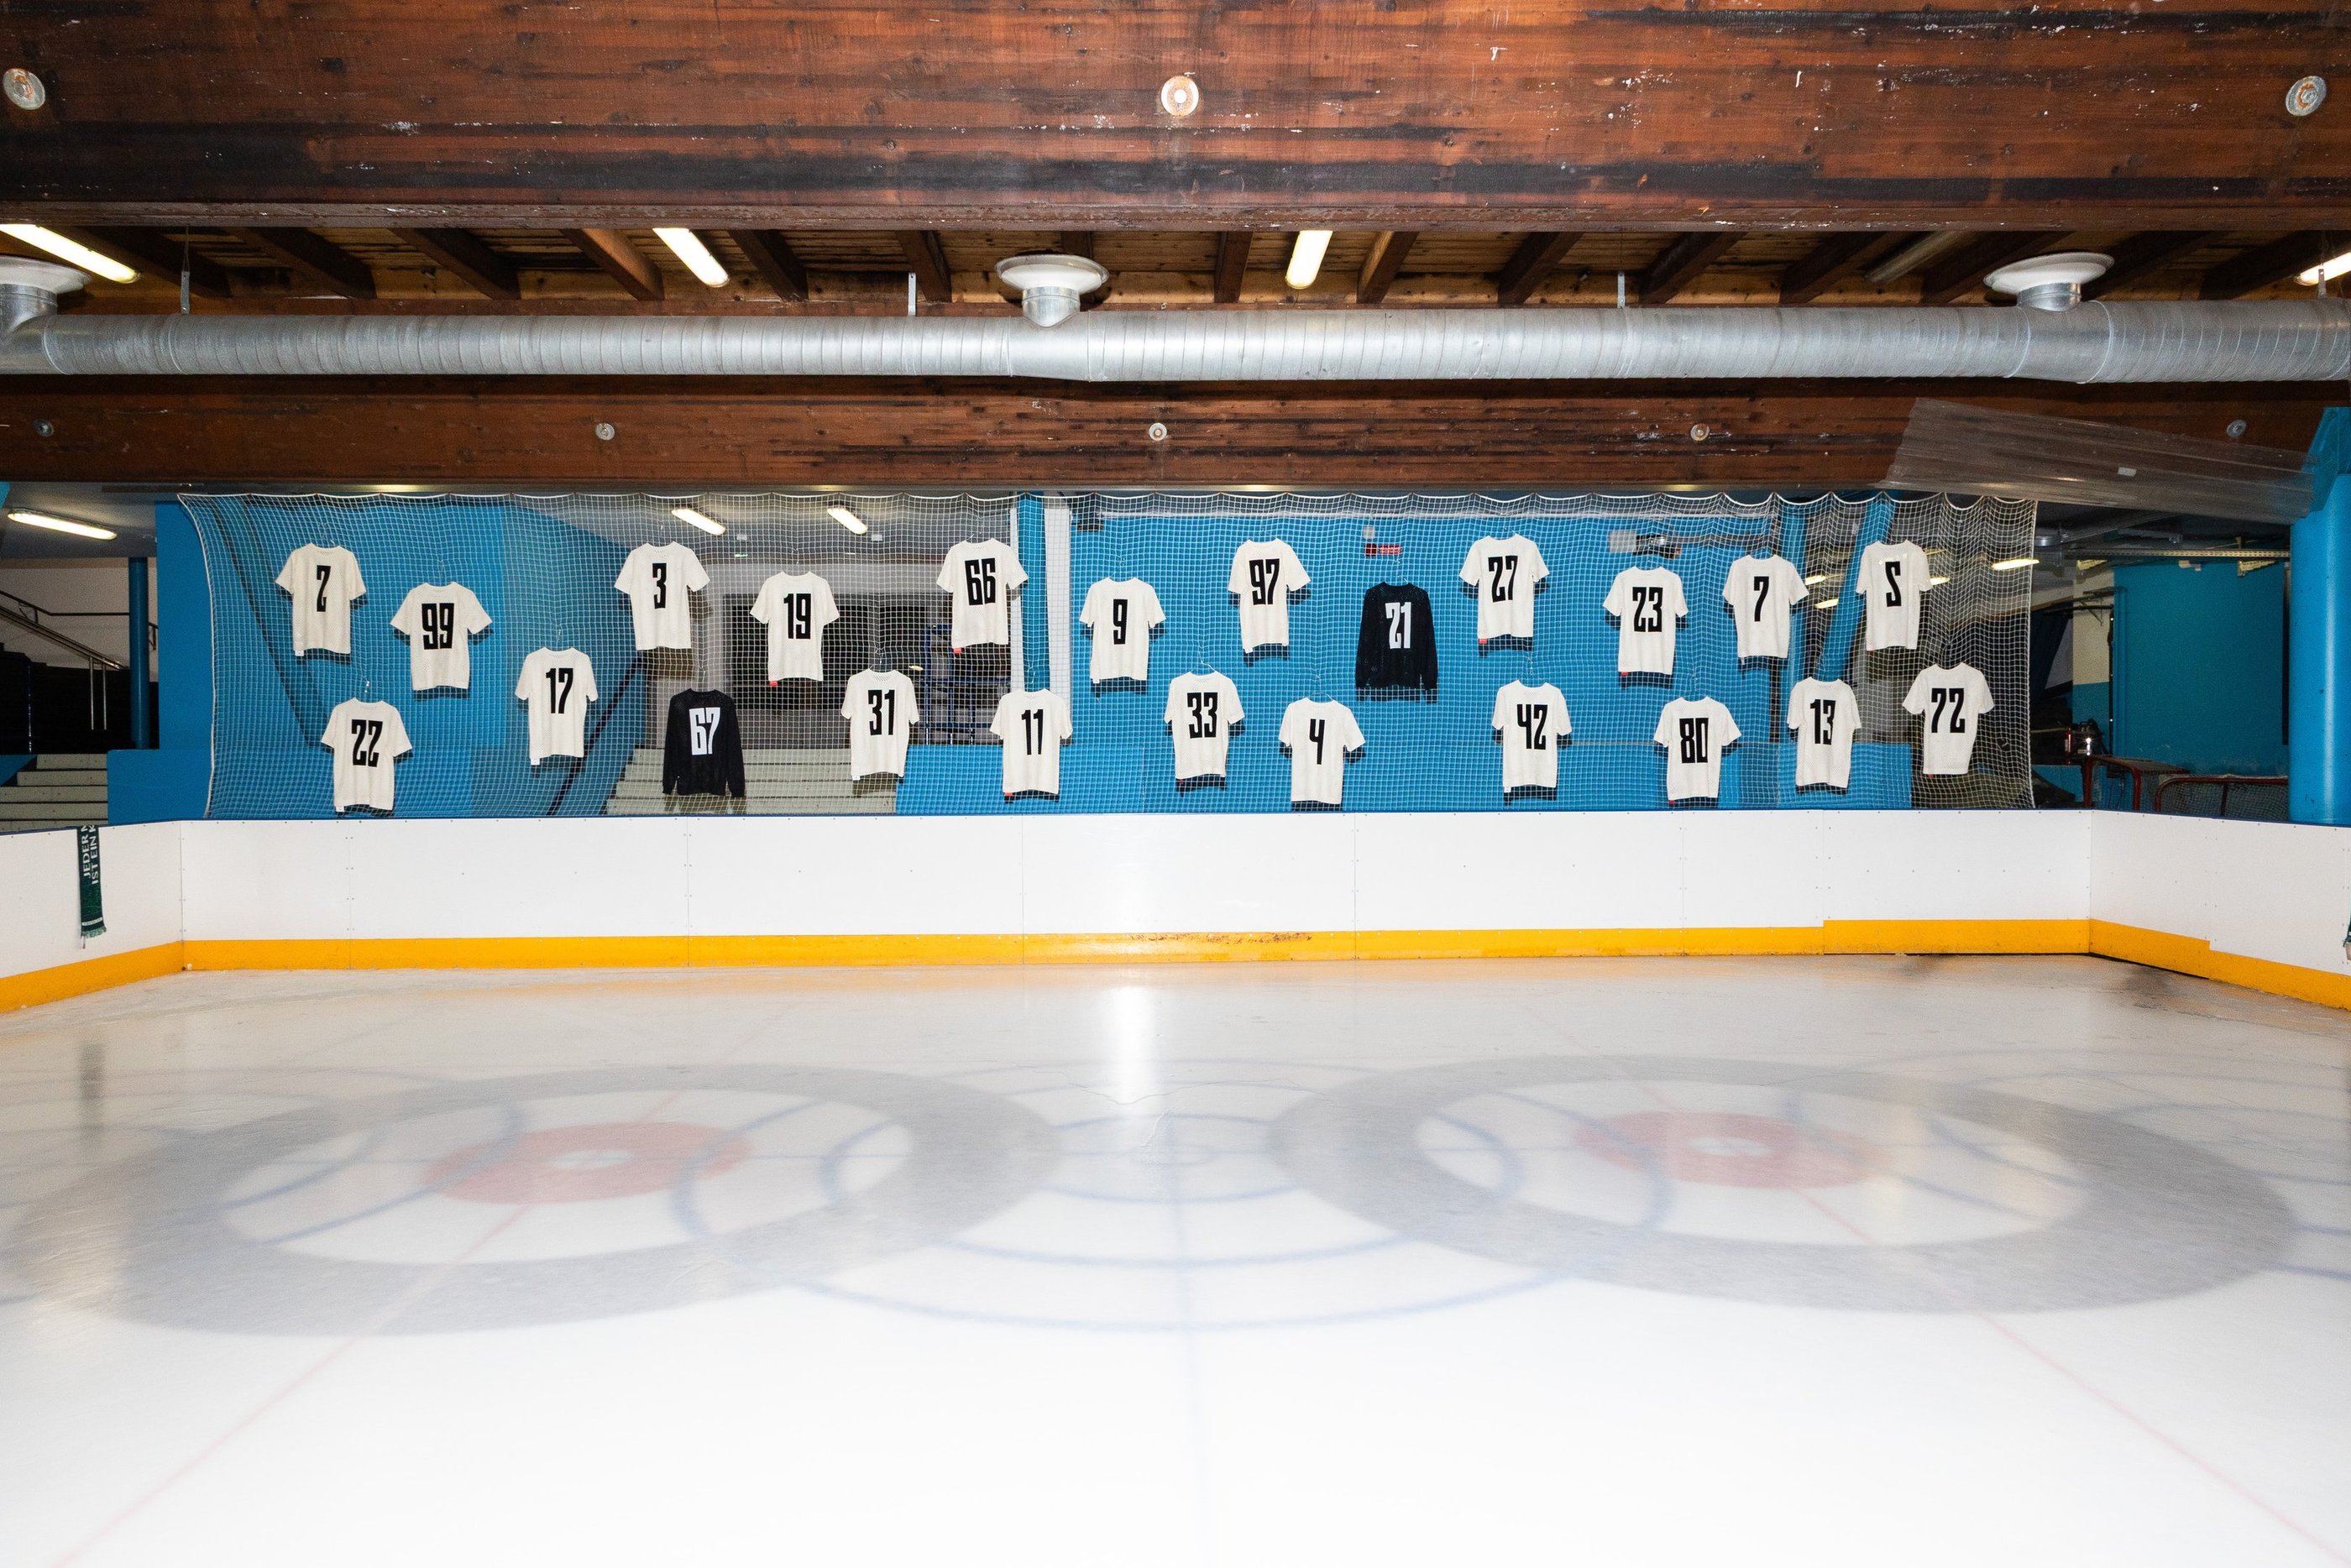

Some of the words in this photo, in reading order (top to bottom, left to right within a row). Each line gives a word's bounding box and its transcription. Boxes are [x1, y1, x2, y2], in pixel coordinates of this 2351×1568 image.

[317, 565, 331, 612] 2
[652, 563, 666, 609] 3
[965, 558, 995, 605] 66
[1249, 559, 1280, 605] 97
[1489, 556, 1517, 602] 27
[1754, 577, 1769, 621] 7
[422, 603, 454, 650] 99
[784, 593, 811, 639] 19
[1113, 599, 1128, 645] 9
[1385, 602, 1411, 649] 21
[1632, 587, 1662, 632] 23
[546, 668, 573, 713] 17
[868, 690, 894, 735] 31
[1931, 688, 1965, 733] 72
[689, 708, 720, 755] 67
[1022, 709, 1043, 755] 11
[1187, 693, 1217, 739] 33
[1517, 704, 1547, 750] 42
[1810, 699, 1835, 745] 13
[352, 719, 383, 767] 22
[1310, 719, 1325, 765] 4
[1679, 718, 1709, 763] 80
[81, 834, 92, 878] JEDER
[89, 836, 98, 859] EIN
